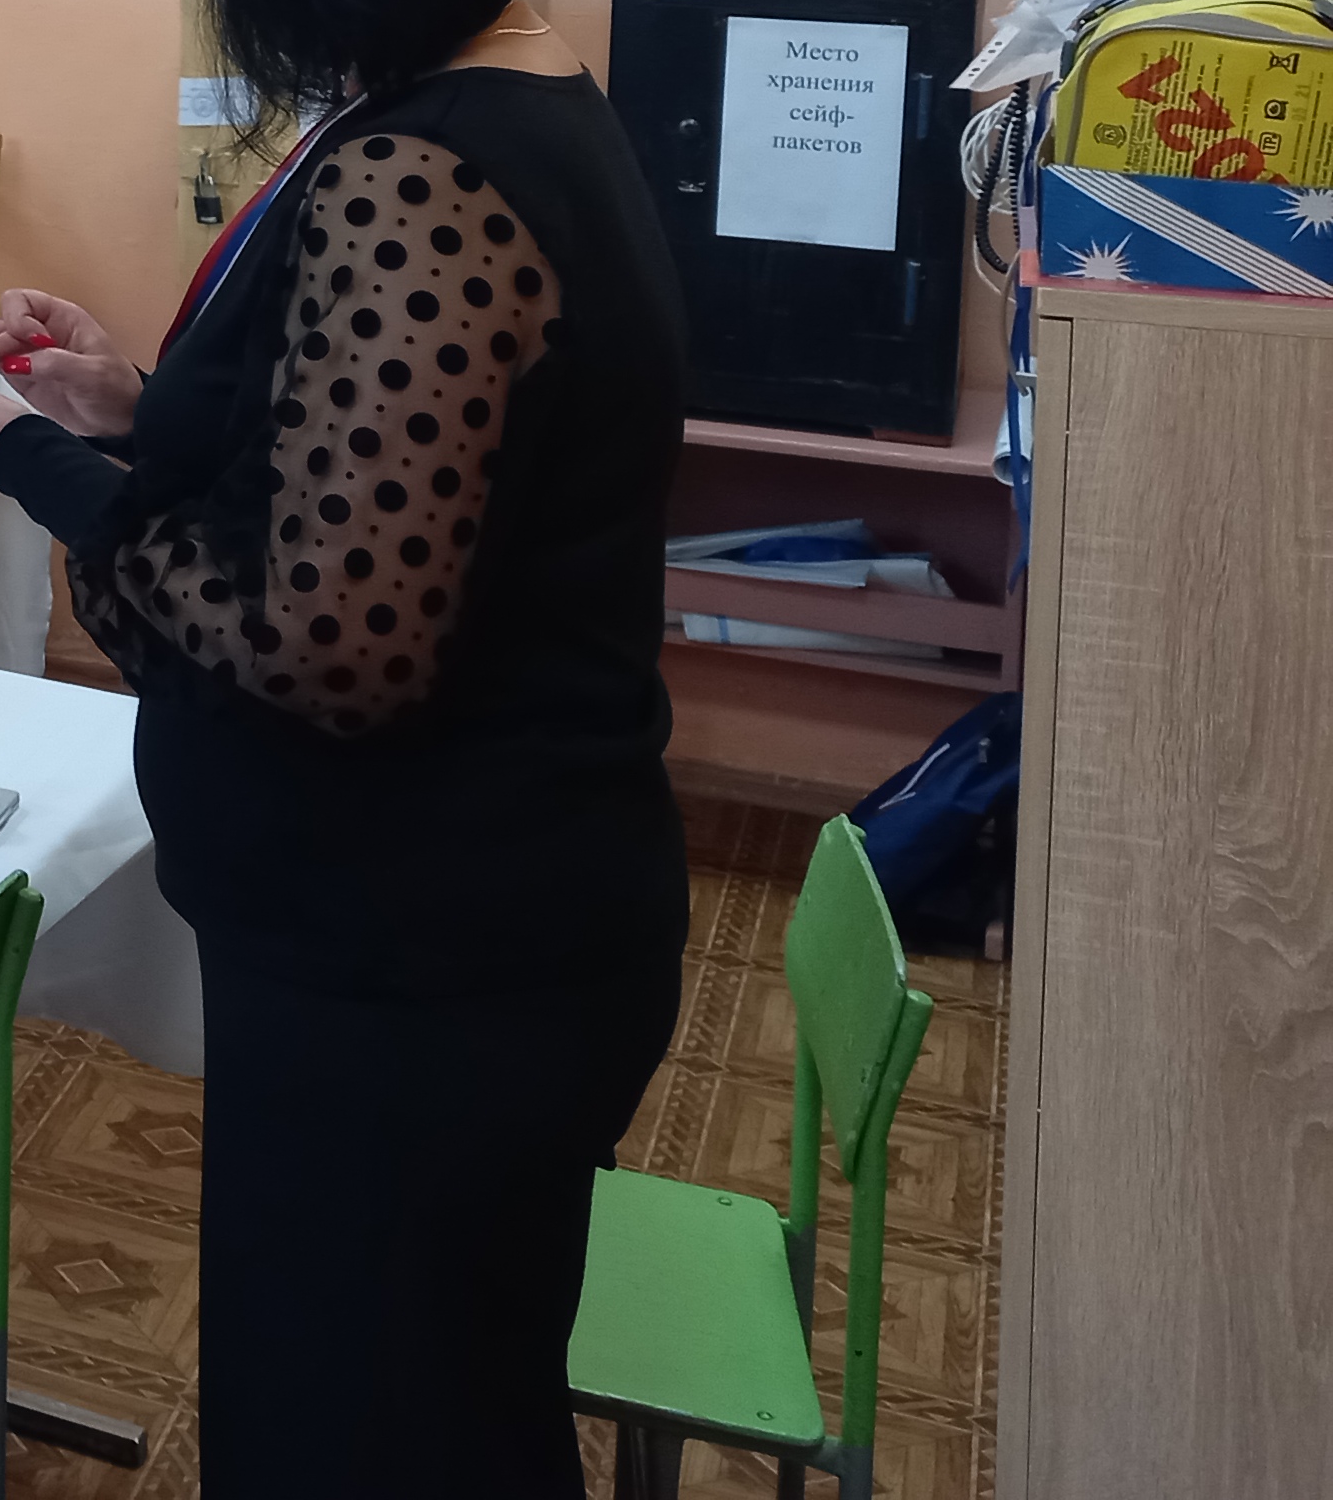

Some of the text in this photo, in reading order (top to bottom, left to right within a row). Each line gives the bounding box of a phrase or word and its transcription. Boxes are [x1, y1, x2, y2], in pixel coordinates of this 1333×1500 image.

[785, 41, 860, 63] Место
[767, 72, 875, 94] хранения
[789, 104, 856, 129] сейф-
[772, 134, 864, 155] пакетов
